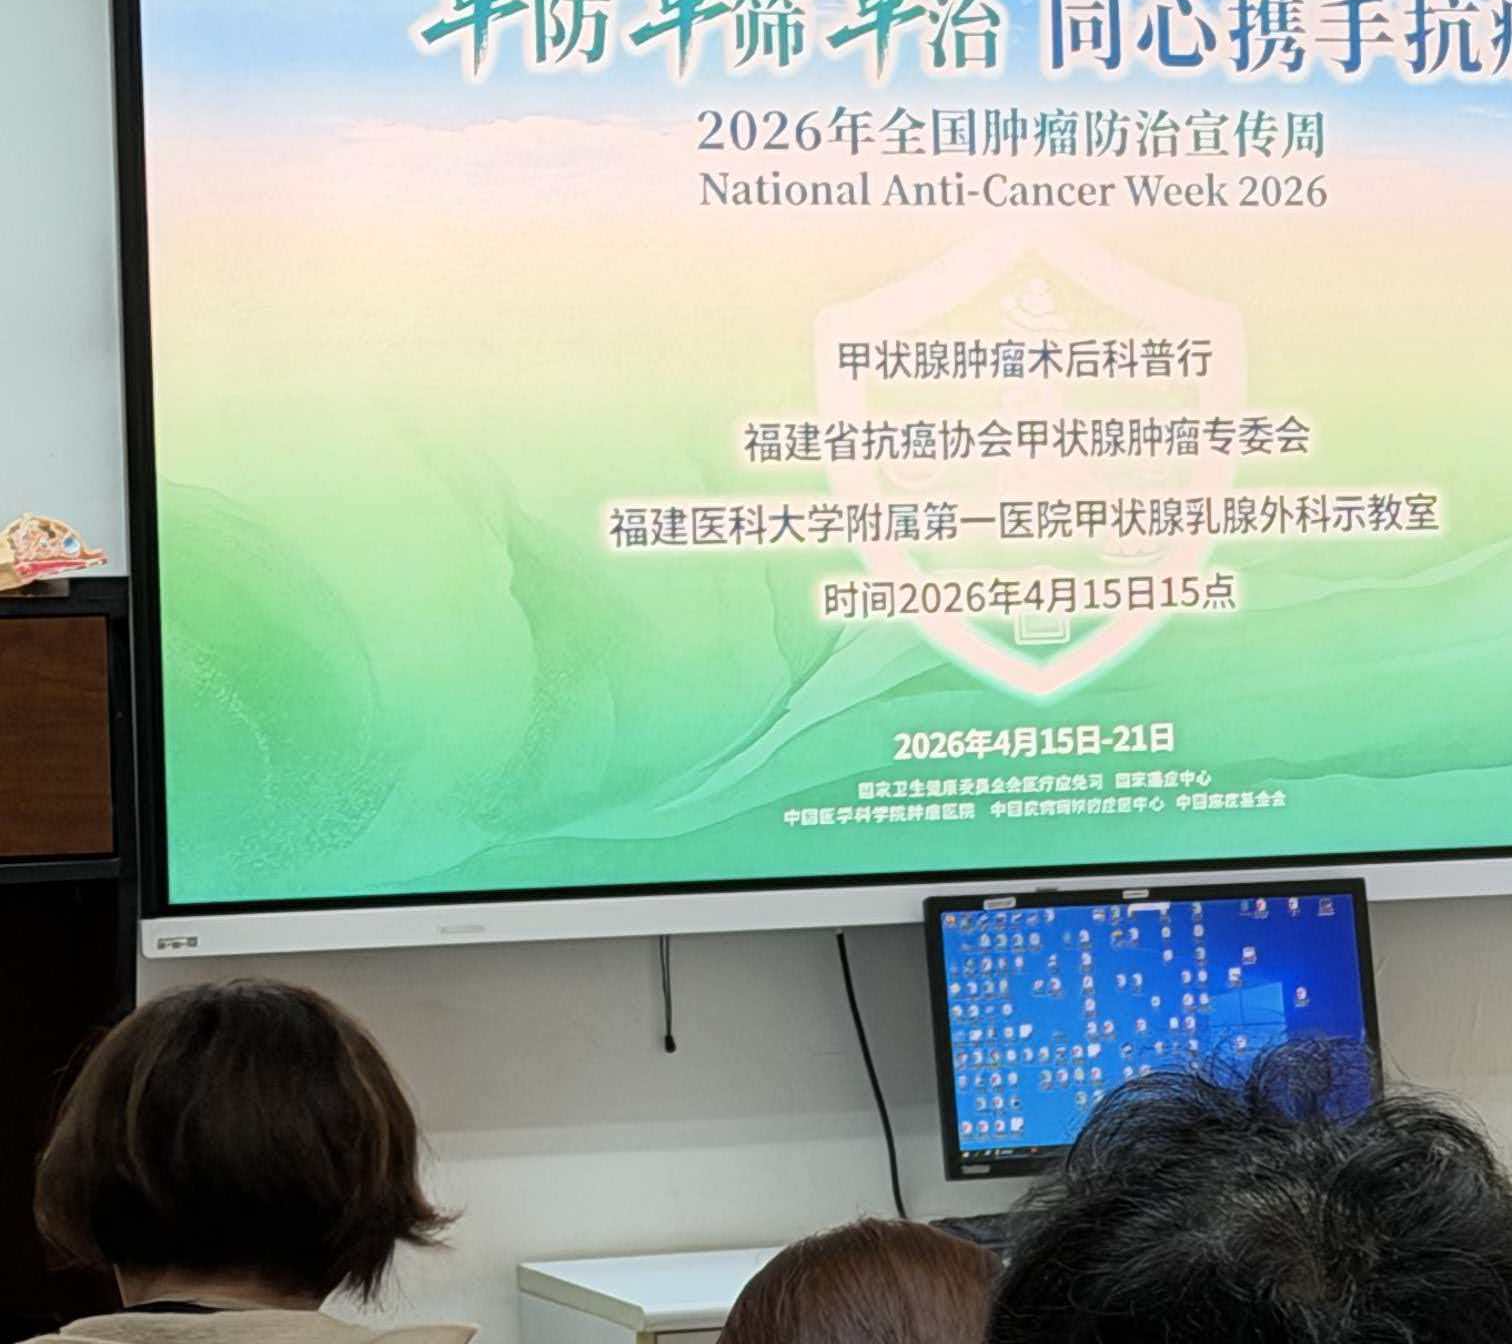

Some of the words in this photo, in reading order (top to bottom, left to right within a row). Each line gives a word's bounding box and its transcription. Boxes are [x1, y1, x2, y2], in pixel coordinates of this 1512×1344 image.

[695, 107, 1327, 157] 2026年全国肿瘤防治宣传周
[699, 171, 870, 208] National
[882, 172, 1116, 208] Anti-Cancer
[1125, 173, 1230, 208] Week
[1238, 174, 1329, 208] 2026
[836, 338, 1214, 381] 甲状腺肿瘤术后科普行
[743, 414, 1312, 463] 福建省抗癌协会甲状腺肿瘤专委会
[608, 493, 1440, 547] 福建医科大学附属第一医院甲状腺乳腺外科示教室
[822, 572, 1238, 619] 时间2026年4月15日15点
[893, 721, 1175, 761] 2026年4月15日-21日
